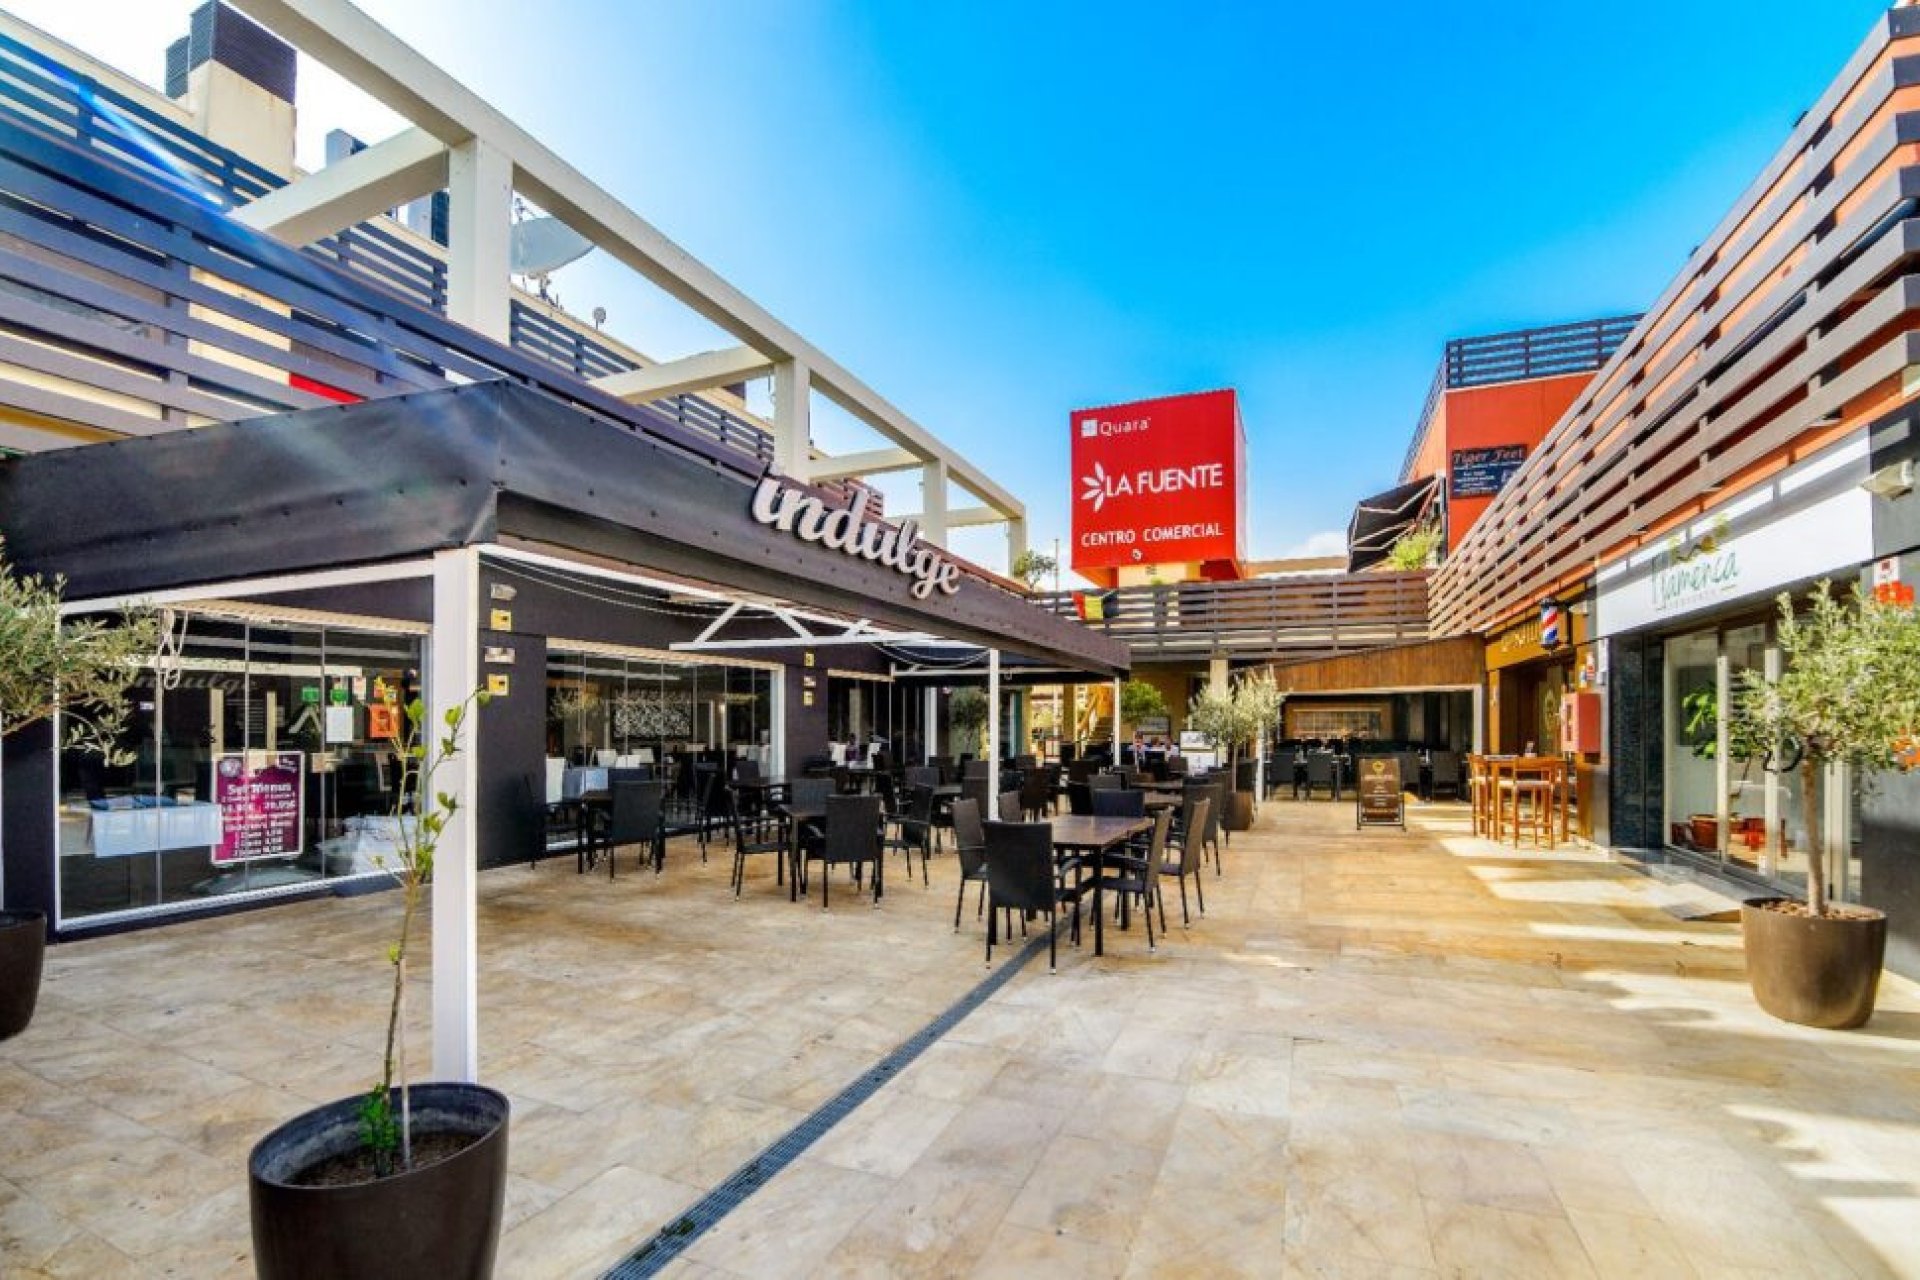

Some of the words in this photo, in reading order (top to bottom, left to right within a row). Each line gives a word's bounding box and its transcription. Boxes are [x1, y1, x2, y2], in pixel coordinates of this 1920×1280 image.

[1100, 418, 1149, 436] Quara
[1106, 473, 1133, 497] LA
[1137, 463, 1223, 494] FUENTE
[752, 478, 960, 600] indulge
[1081, 529, 1136, 547] CENTRO
[1143, 522, 1224, 542] COMERCIAL
